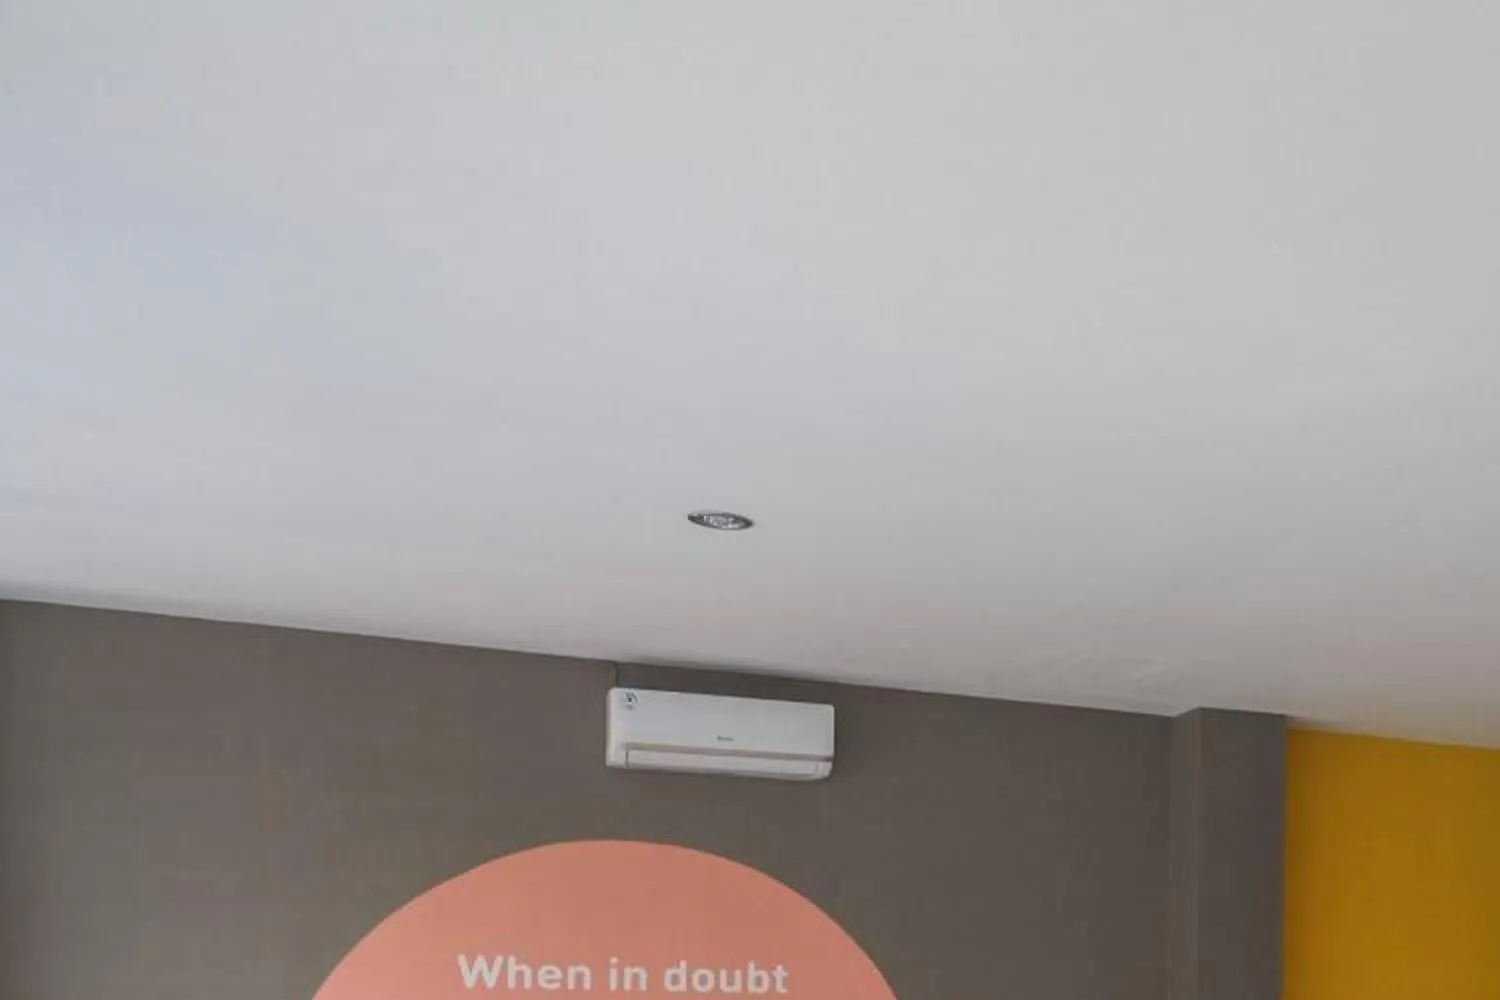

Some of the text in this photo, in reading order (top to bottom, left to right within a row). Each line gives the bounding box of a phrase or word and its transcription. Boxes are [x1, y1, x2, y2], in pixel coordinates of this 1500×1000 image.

[457, 953, 789, 994] When in doubt
